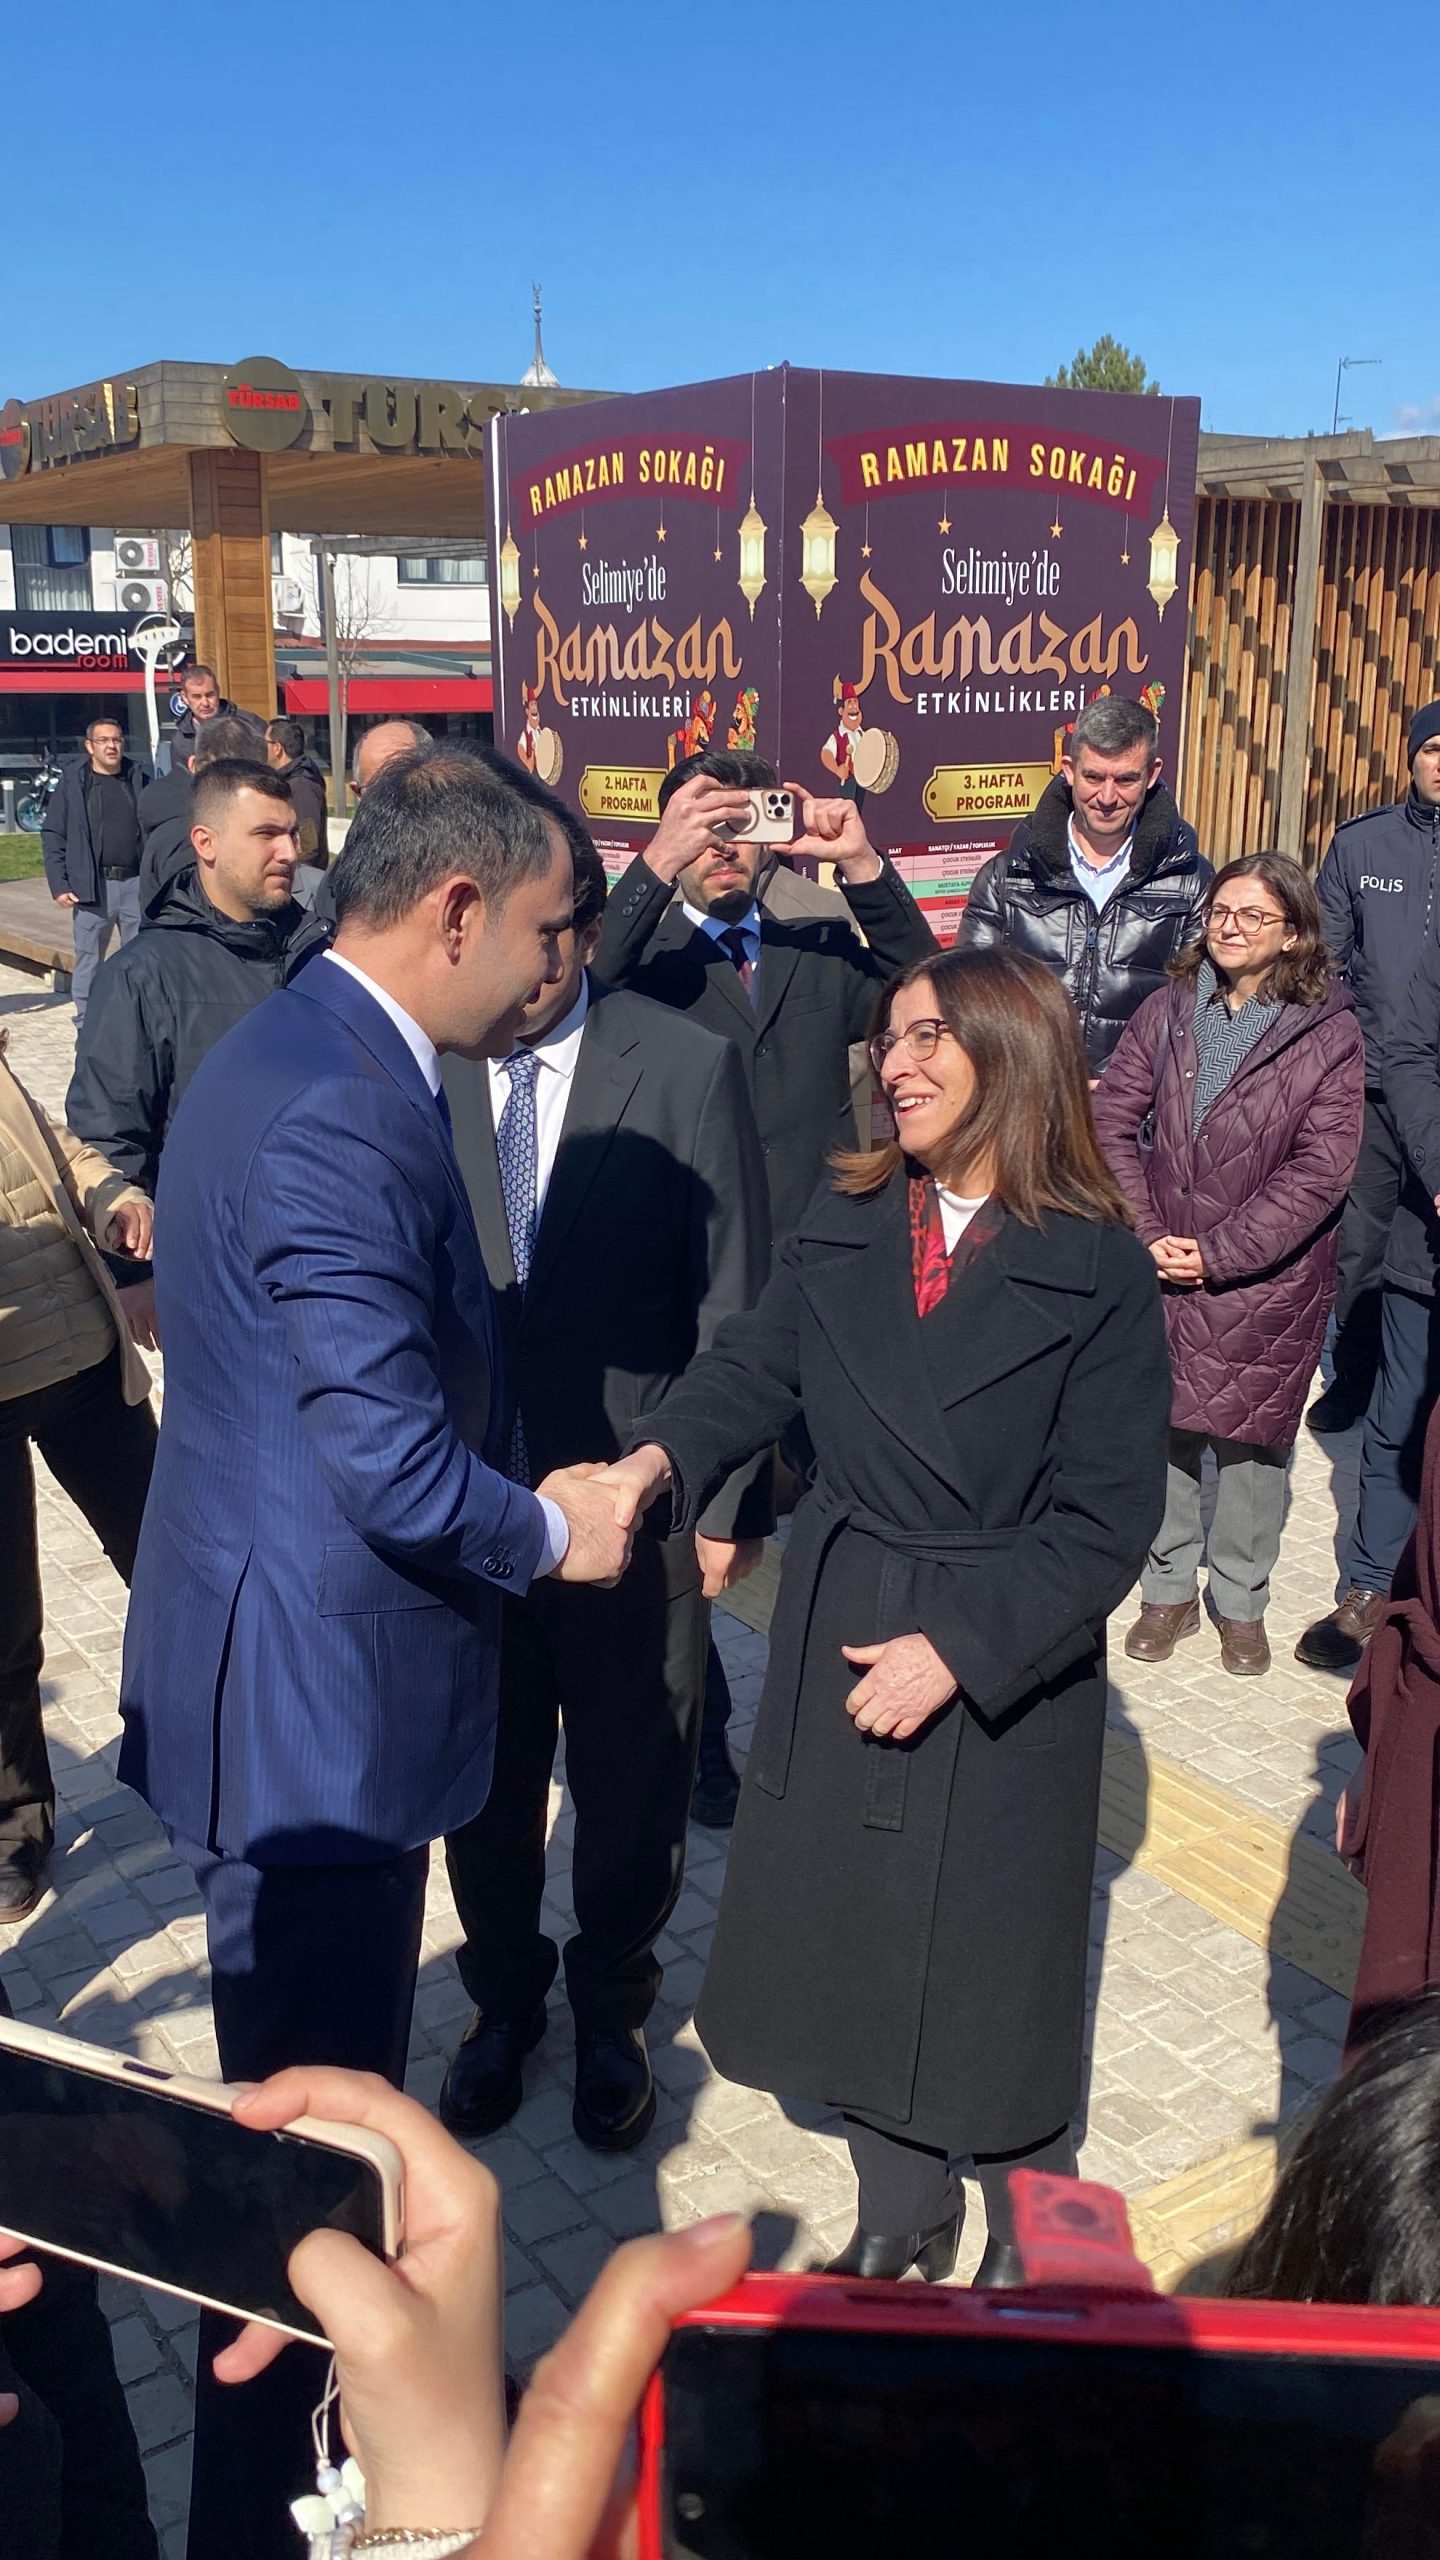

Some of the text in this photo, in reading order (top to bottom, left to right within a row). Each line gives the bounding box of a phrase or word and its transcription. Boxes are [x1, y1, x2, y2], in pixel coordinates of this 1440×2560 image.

[228, 384, 299, 411] TÜRSAB
[529, 445, 726, 516] RAMAZAN SOKAĞI
[860, 438, 1137, 501] RAMAZAN SOKAĞI
[9, 627, 128, 655] bademi
[522, 586, 743, 707] Ramazan
[833, 567, 1149, 705] Ramazan
[77, 654, 128, 668] room
[571, 690, 691, 718] ETKİNLİKLERİ
[917, 684, 1085, 715] ETKİNLİKLERİ
[605, 775, 647, 792] 2. HAFTA
[963, 773, 1025, 789] 3. HAFTA
[600, 796, 653, 812] PROGRAMI
[956, 793, 1030, 811] PROGRAMI
